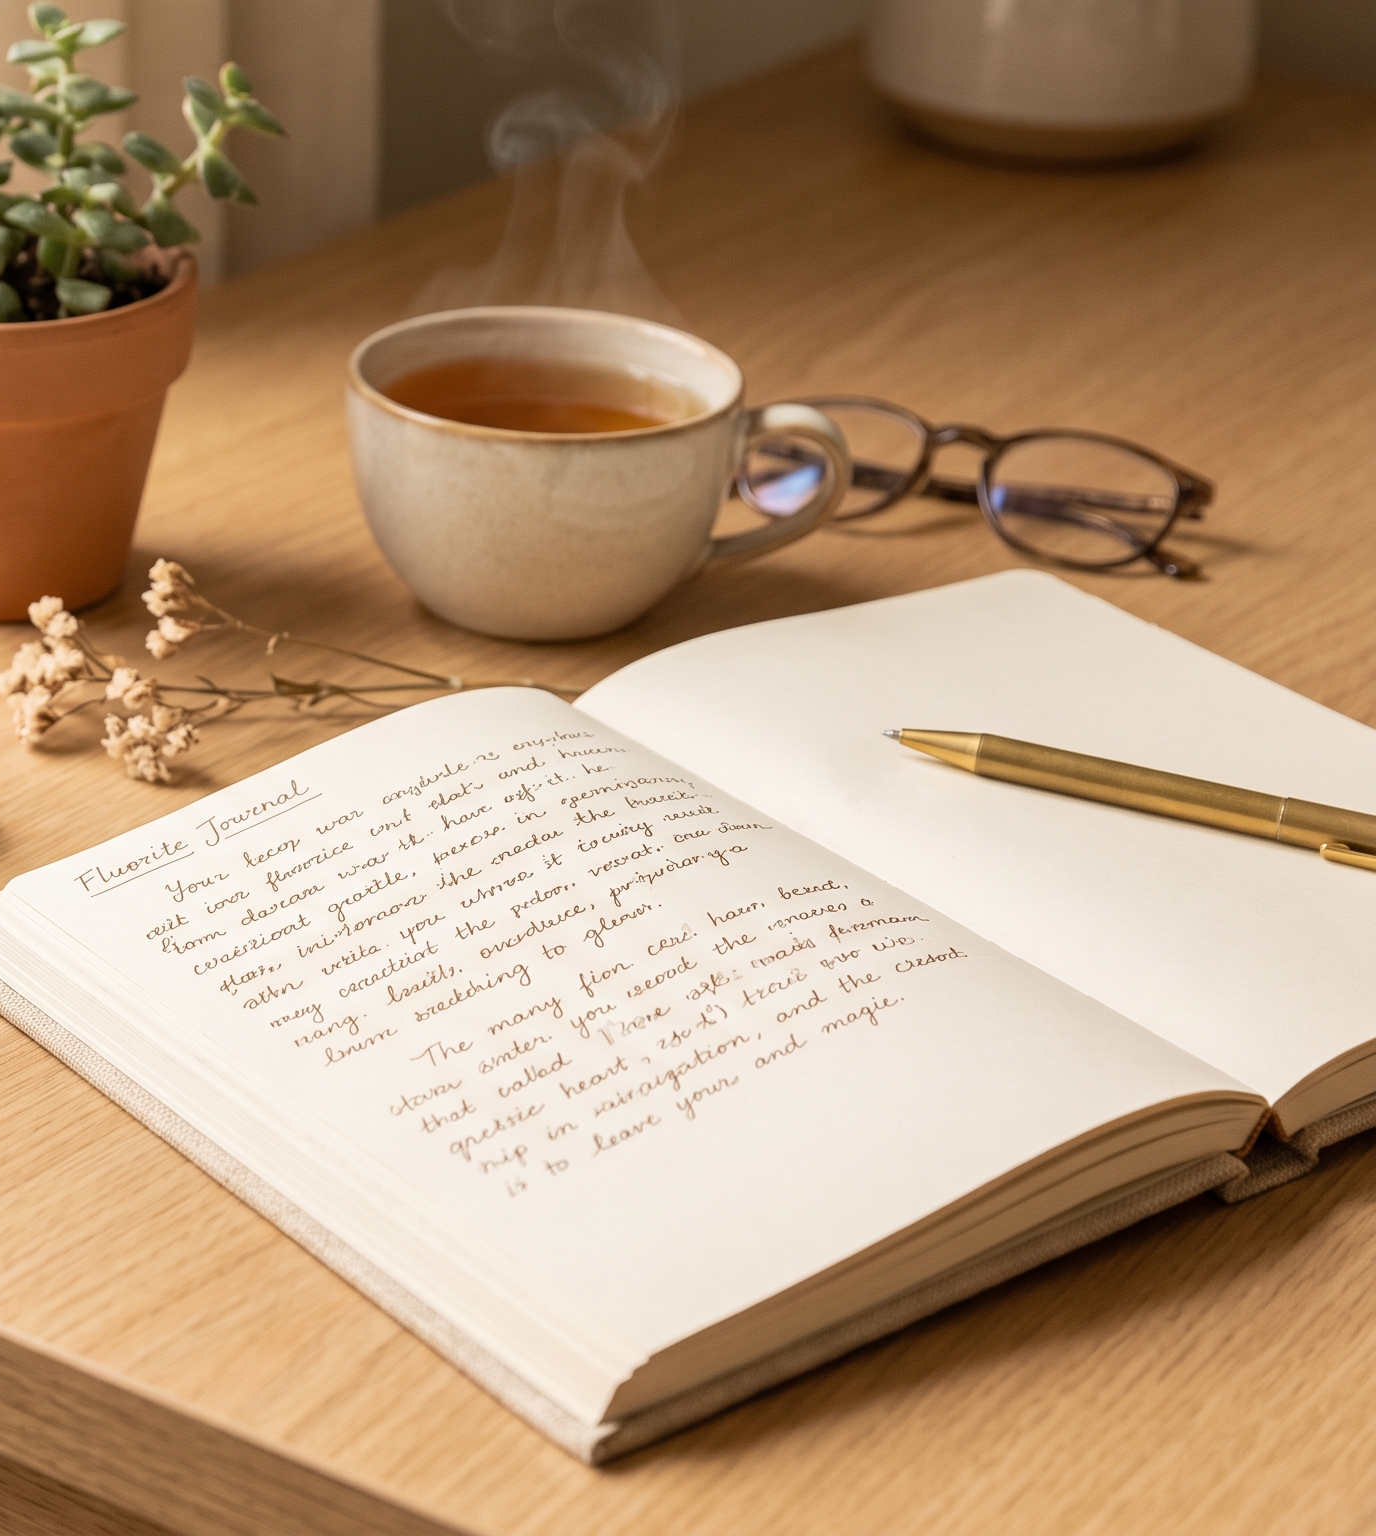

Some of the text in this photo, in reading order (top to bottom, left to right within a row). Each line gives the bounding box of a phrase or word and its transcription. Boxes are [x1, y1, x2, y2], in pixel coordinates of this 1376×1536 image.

[498, 757, 545, 780] and
[440, 806, 492, 832] have
[515, 810, 546, 824] in
[574, 809, 615, 826] the
[74, 780, 309, 891] Fluorite Journal
[165, 874, 229, 902] Your
[400, 915, 446, 944] you
[455, 919, 496, 940] the
[542, 944, 567, 960] to
[570, 1004, 617, 1039] you
[712, 934, 757, 955] the
[410, 1041, 474, 1067] The
[487, 997, 564, 1036] many
[545, 1121, 579, 1141] in
[776, 990, 828, 1023] and
[837, 973, 882, 994] the
[421, 1099, 477, 1134] that
[543, 1158, 570, 1177] to
[591, 1113, 662, 1159] leave
[754, 1033, 808, 1069] and
